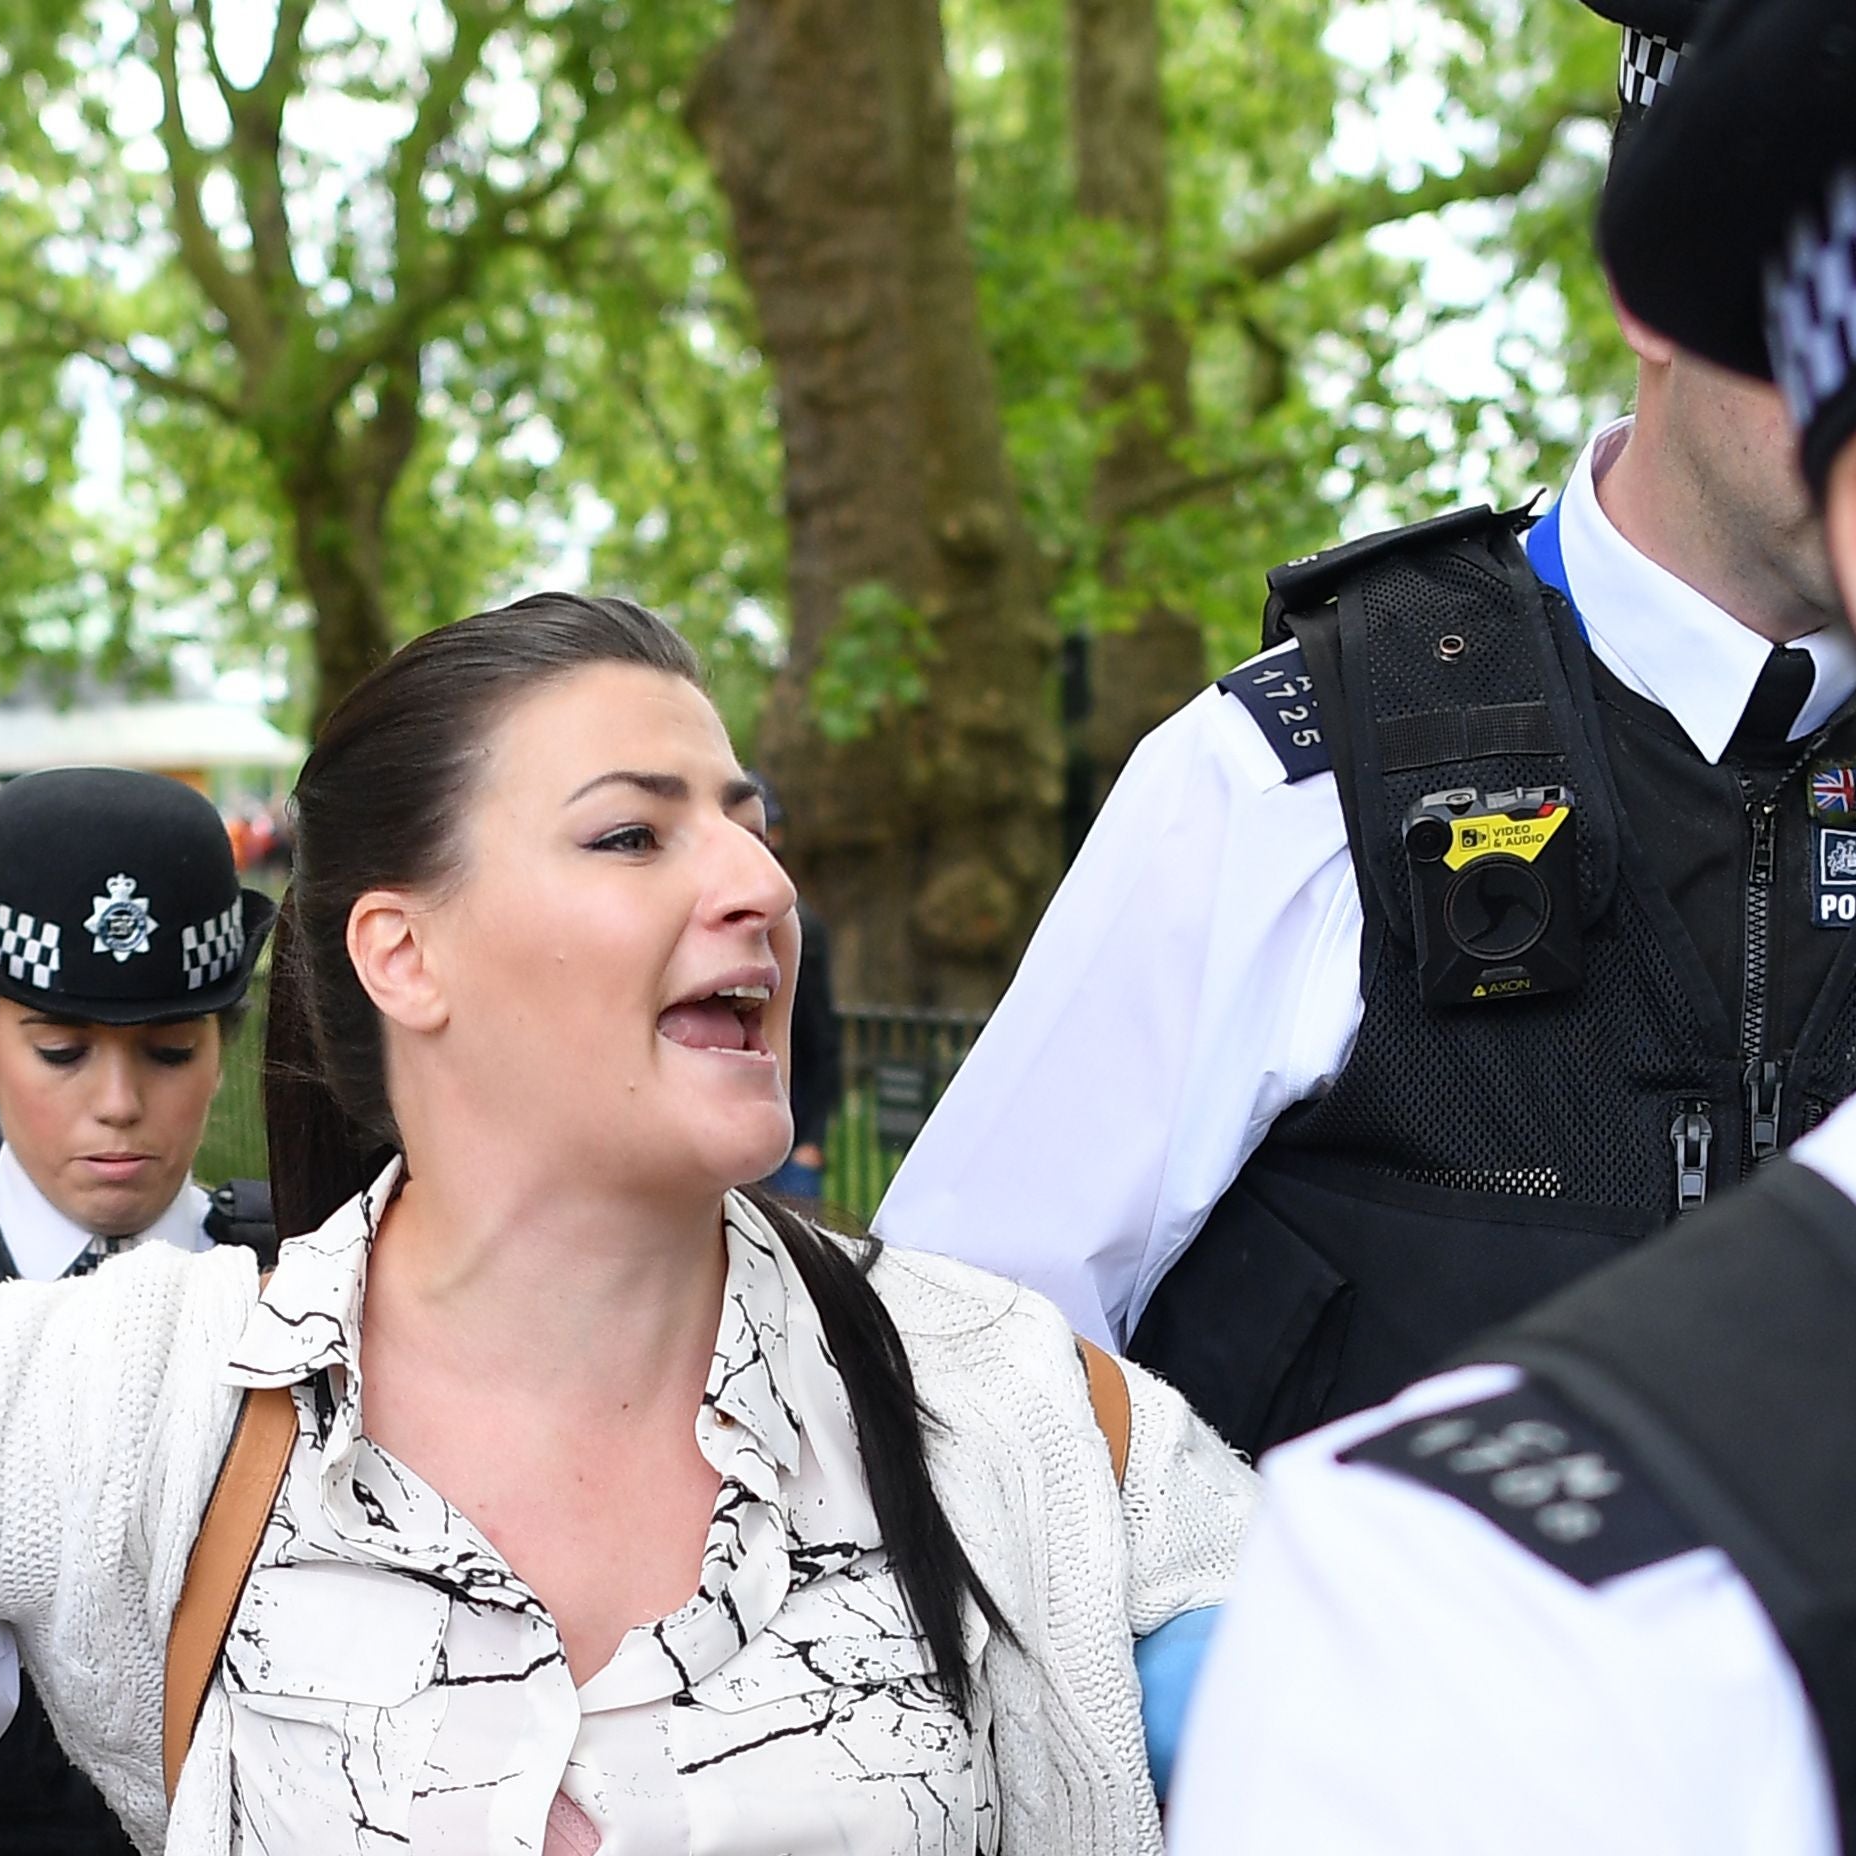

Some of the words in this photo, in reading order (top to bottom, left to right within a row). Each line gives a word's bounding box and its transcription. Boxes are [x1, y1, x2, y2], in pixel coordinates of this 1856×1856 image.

[1252, 669, 1322, 748] 1725
[1492, 824, 1531, 837] VIDEO
[1494, 839, 1501, 848] &
[1505, 833, 1545, 847] AUDIO
[1488, 979, 1531, 993] AXON
